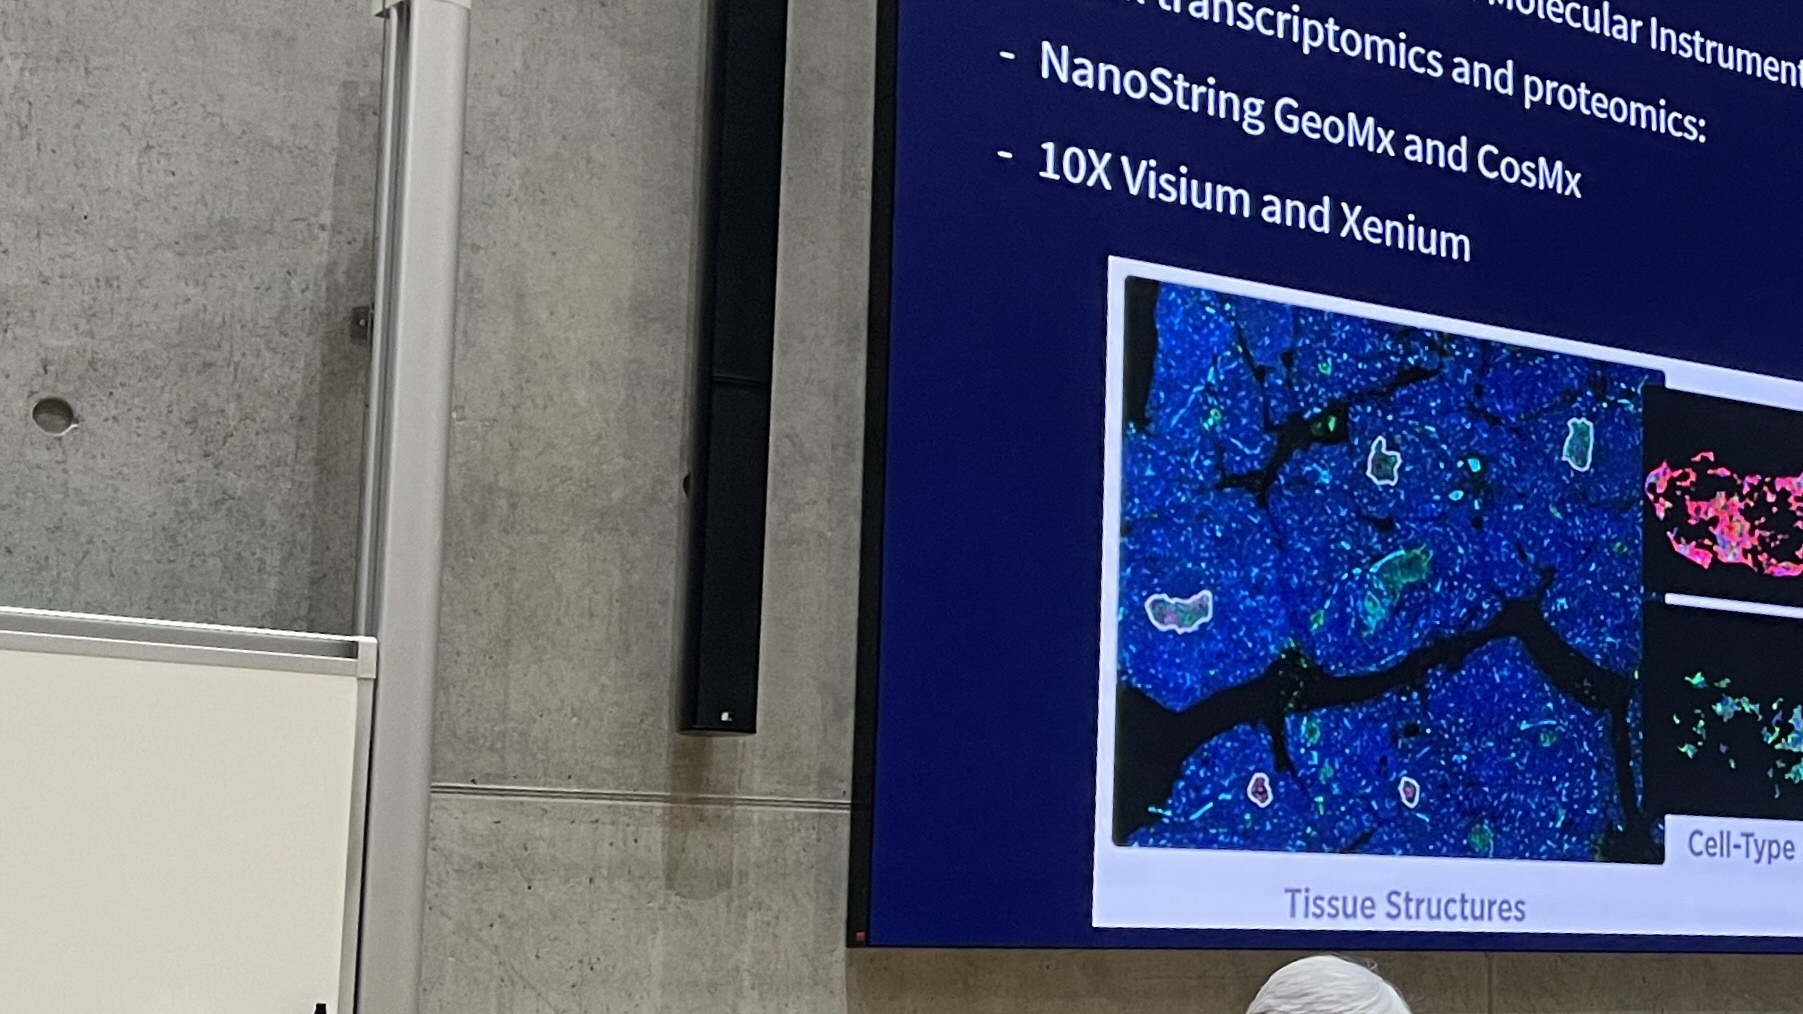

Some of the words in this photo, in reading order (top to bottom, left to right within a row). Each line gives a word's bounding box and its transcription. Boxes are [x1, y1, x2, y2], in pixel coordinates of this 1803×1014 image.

[1041, 40, 1266, 136] NanoString
[1274, 96, 1396, 157] GeoMx
[1403, 133, 1468, 173] and
[1477, 143, 1583, 199] CosMx
[1451, 56, 1514, 97] and
[1523, 75, 1707, 144] proteomics:
[1038, 141, 1113, 191] 10X
[1120, 155, 1251, 218] Visium
[1260, 194, 1331, 234] and
[1339, 201, 1472, 263] Xenium
[1687, 828, 1796, 866] Cell-Type
[1283, 886, 1376, 920] Tissue
[1385, 889, 1527, 923] Structures
